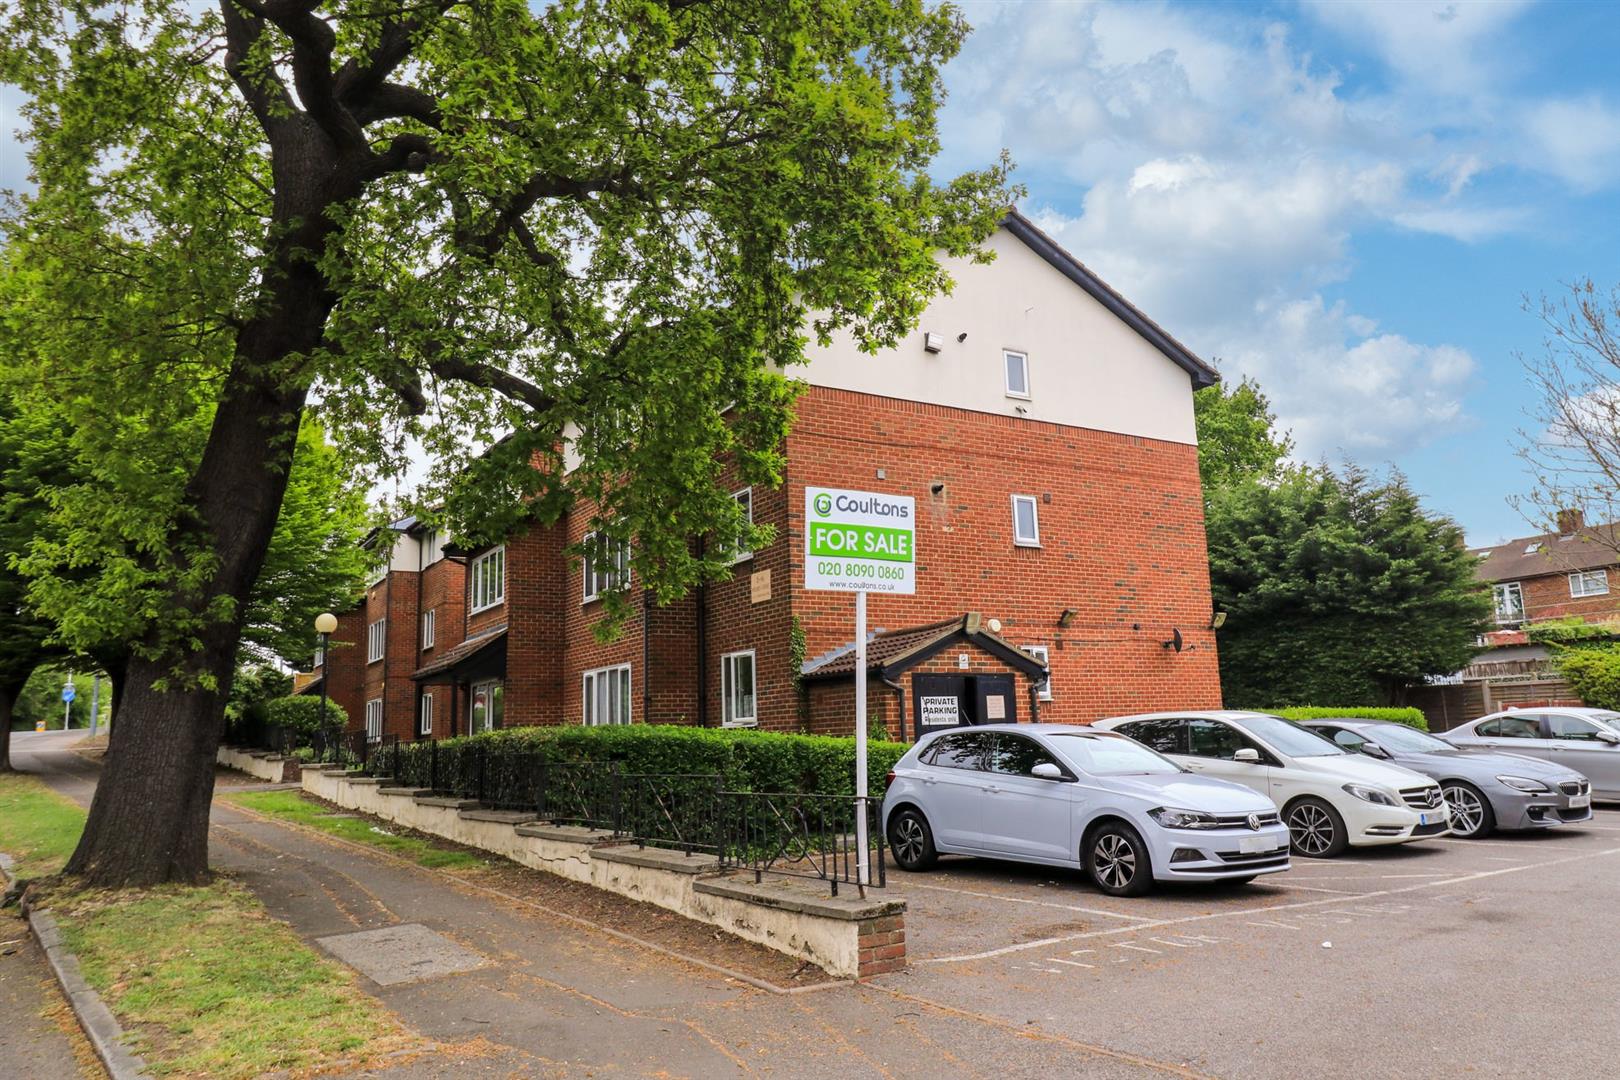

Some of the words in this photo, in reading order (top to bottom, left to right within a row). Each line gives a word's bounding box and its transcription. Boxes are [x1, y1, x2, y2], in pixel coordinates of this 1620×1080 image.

[836, 495, 908, 517] Coultons
[816, 528, 858, 551] FOR
[864, 532, 907, 555] SALE
[818, 562, 841, 576] 020
[846, 564, 874, 578] 8090
[878, 566, 904, 580] 0860
[829, 581, 895, 590] www.coultons.co.uk
